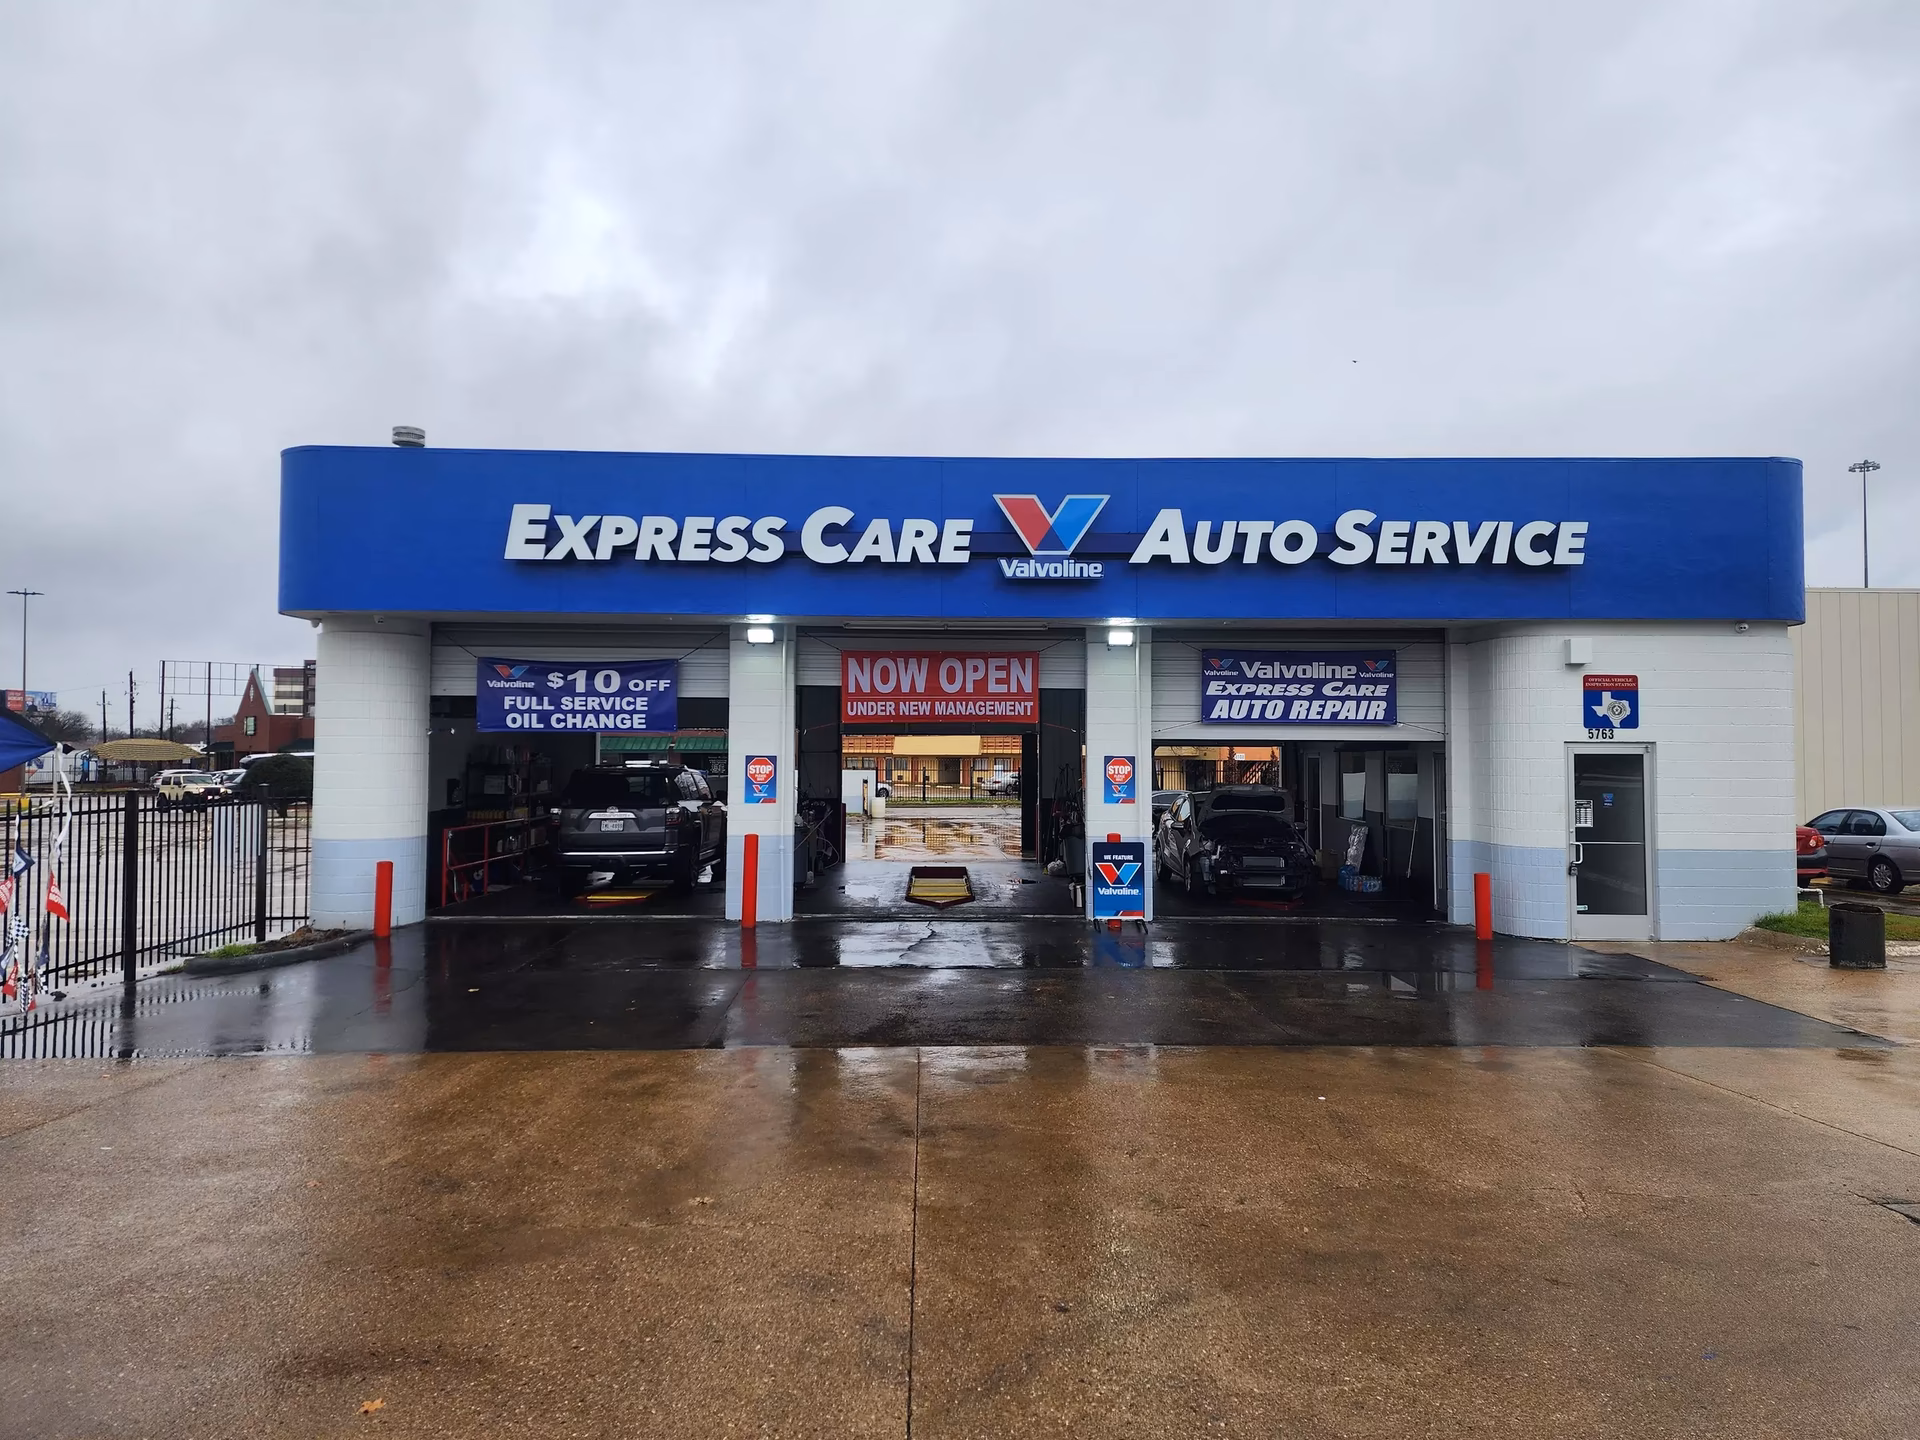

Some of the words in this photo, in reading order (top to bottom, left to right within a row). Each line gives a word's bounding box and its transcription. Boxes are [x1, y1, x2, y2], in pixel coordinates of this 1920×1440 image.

[504, 504, 787, 563] EXPRESS
[801, 505, 974, 563] CARE
[1129, 508, 1318, 564] AUTO
[1327, 509, 1589, 565] SERVICE
[1000, 559, 1104, 577] Valvoline
[848, 657, 929, 694] NOW
[939, 657, 1033, 694] OPEN
[1240, 661, 1357, 679] Valvoline
[487, 680, 535, 688] Valvoline
[546, 669, 621, 693] $10
[628, 679, 671, 691] OFF
[1206, 681, 1315, 697] EXPRESS
[1322, 681, 1389, 697] CARE
[504, 696, 555, 710] FULL
[560, 696, 648, 711] SERVICE
[847, 701, 896, 716] UNDER
[900, 701, 931, 715] NEW
[935, 702, 1033, 716] MANAGEMENT
[1210, 699, 1285, 719] AUTO
[1289, 699, 1387, 720] REPAIR
[506, 713, 544, 728] OIL
[550, 713, 647, 729] CHANGE
[1588, 728, 1614, 739] 5763
[749, 765, 772, 774] STOP
[1108, 765, 1130, 774] STOP
[1097, 887, 1139, 896] Valvoline
